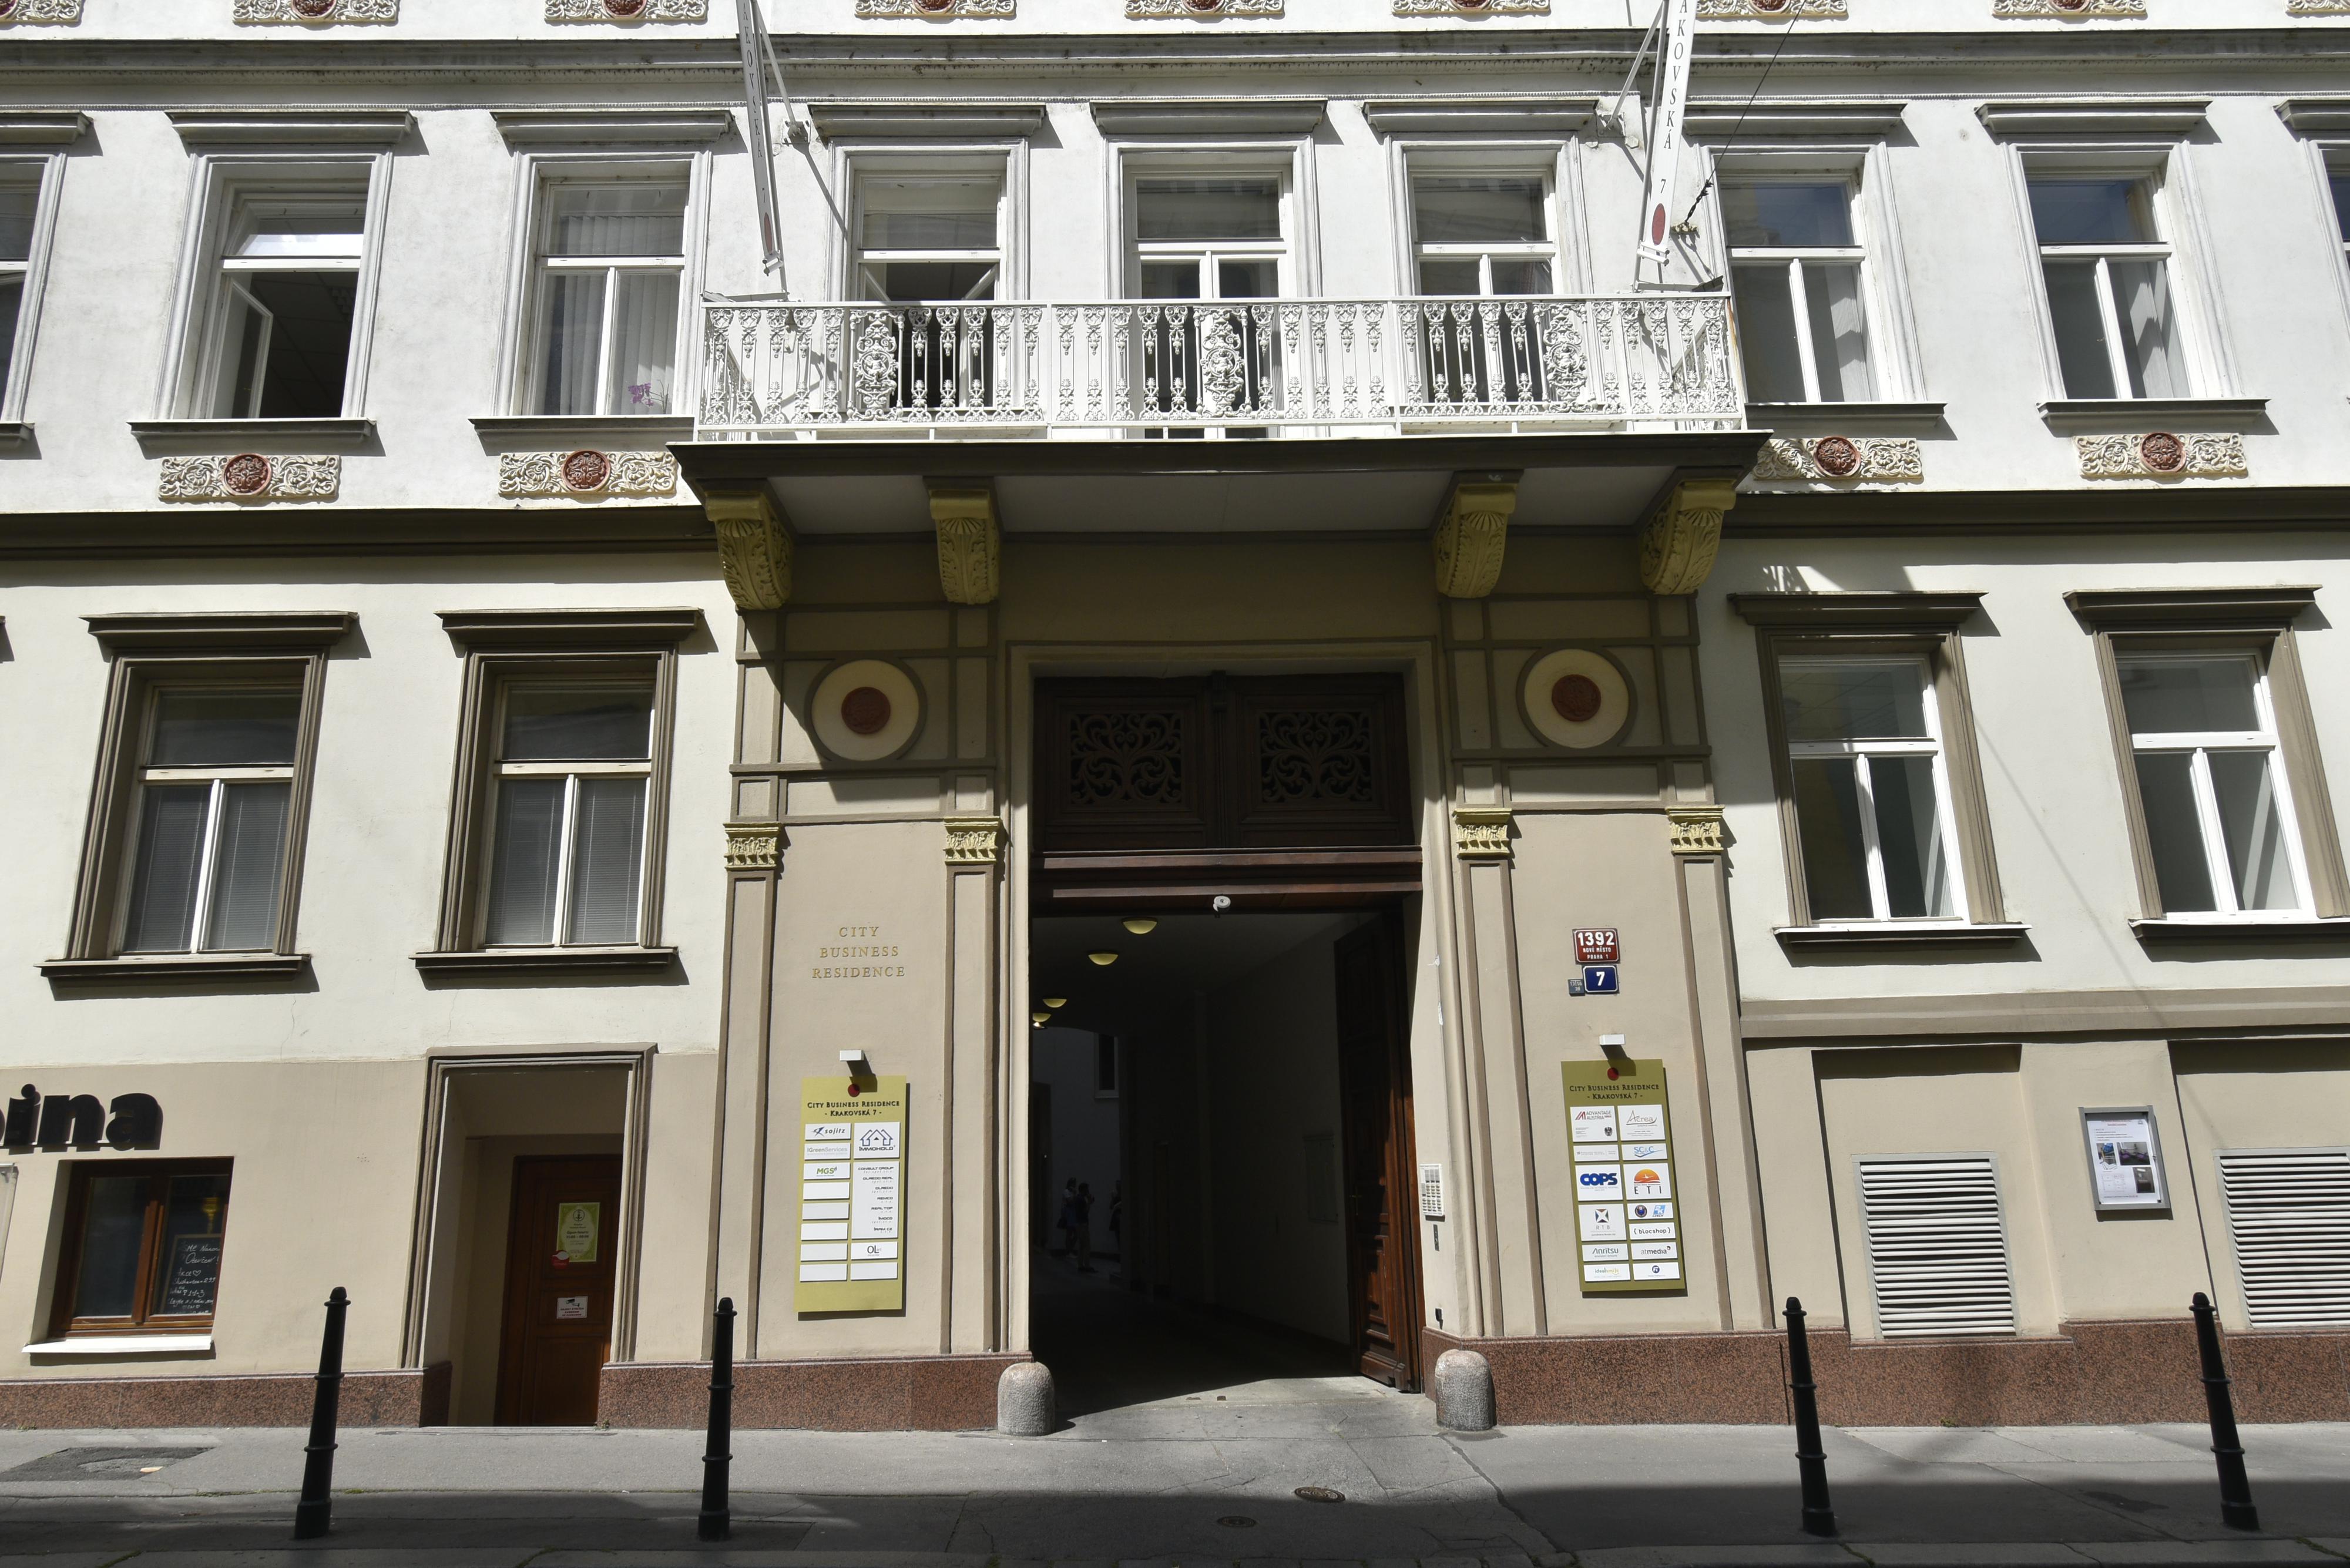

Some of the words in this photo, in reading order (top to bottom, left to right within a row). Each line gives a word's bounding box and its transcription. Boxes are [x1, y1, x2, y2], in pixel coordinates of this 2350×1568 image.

[1660, 179, 1666, 194] 7
[838, 926, 879, 937] CITY
[1577, 932, 1614, 946] 1392
[820, 946, 899, 958] BUSINESS
[812, 966, 905, 979] RESIDENCE
[1596, 971, 1605, 986] 7
[0, 1084, 160, 1150] ina
[1580, 1173, 1618, 1186] COPS
